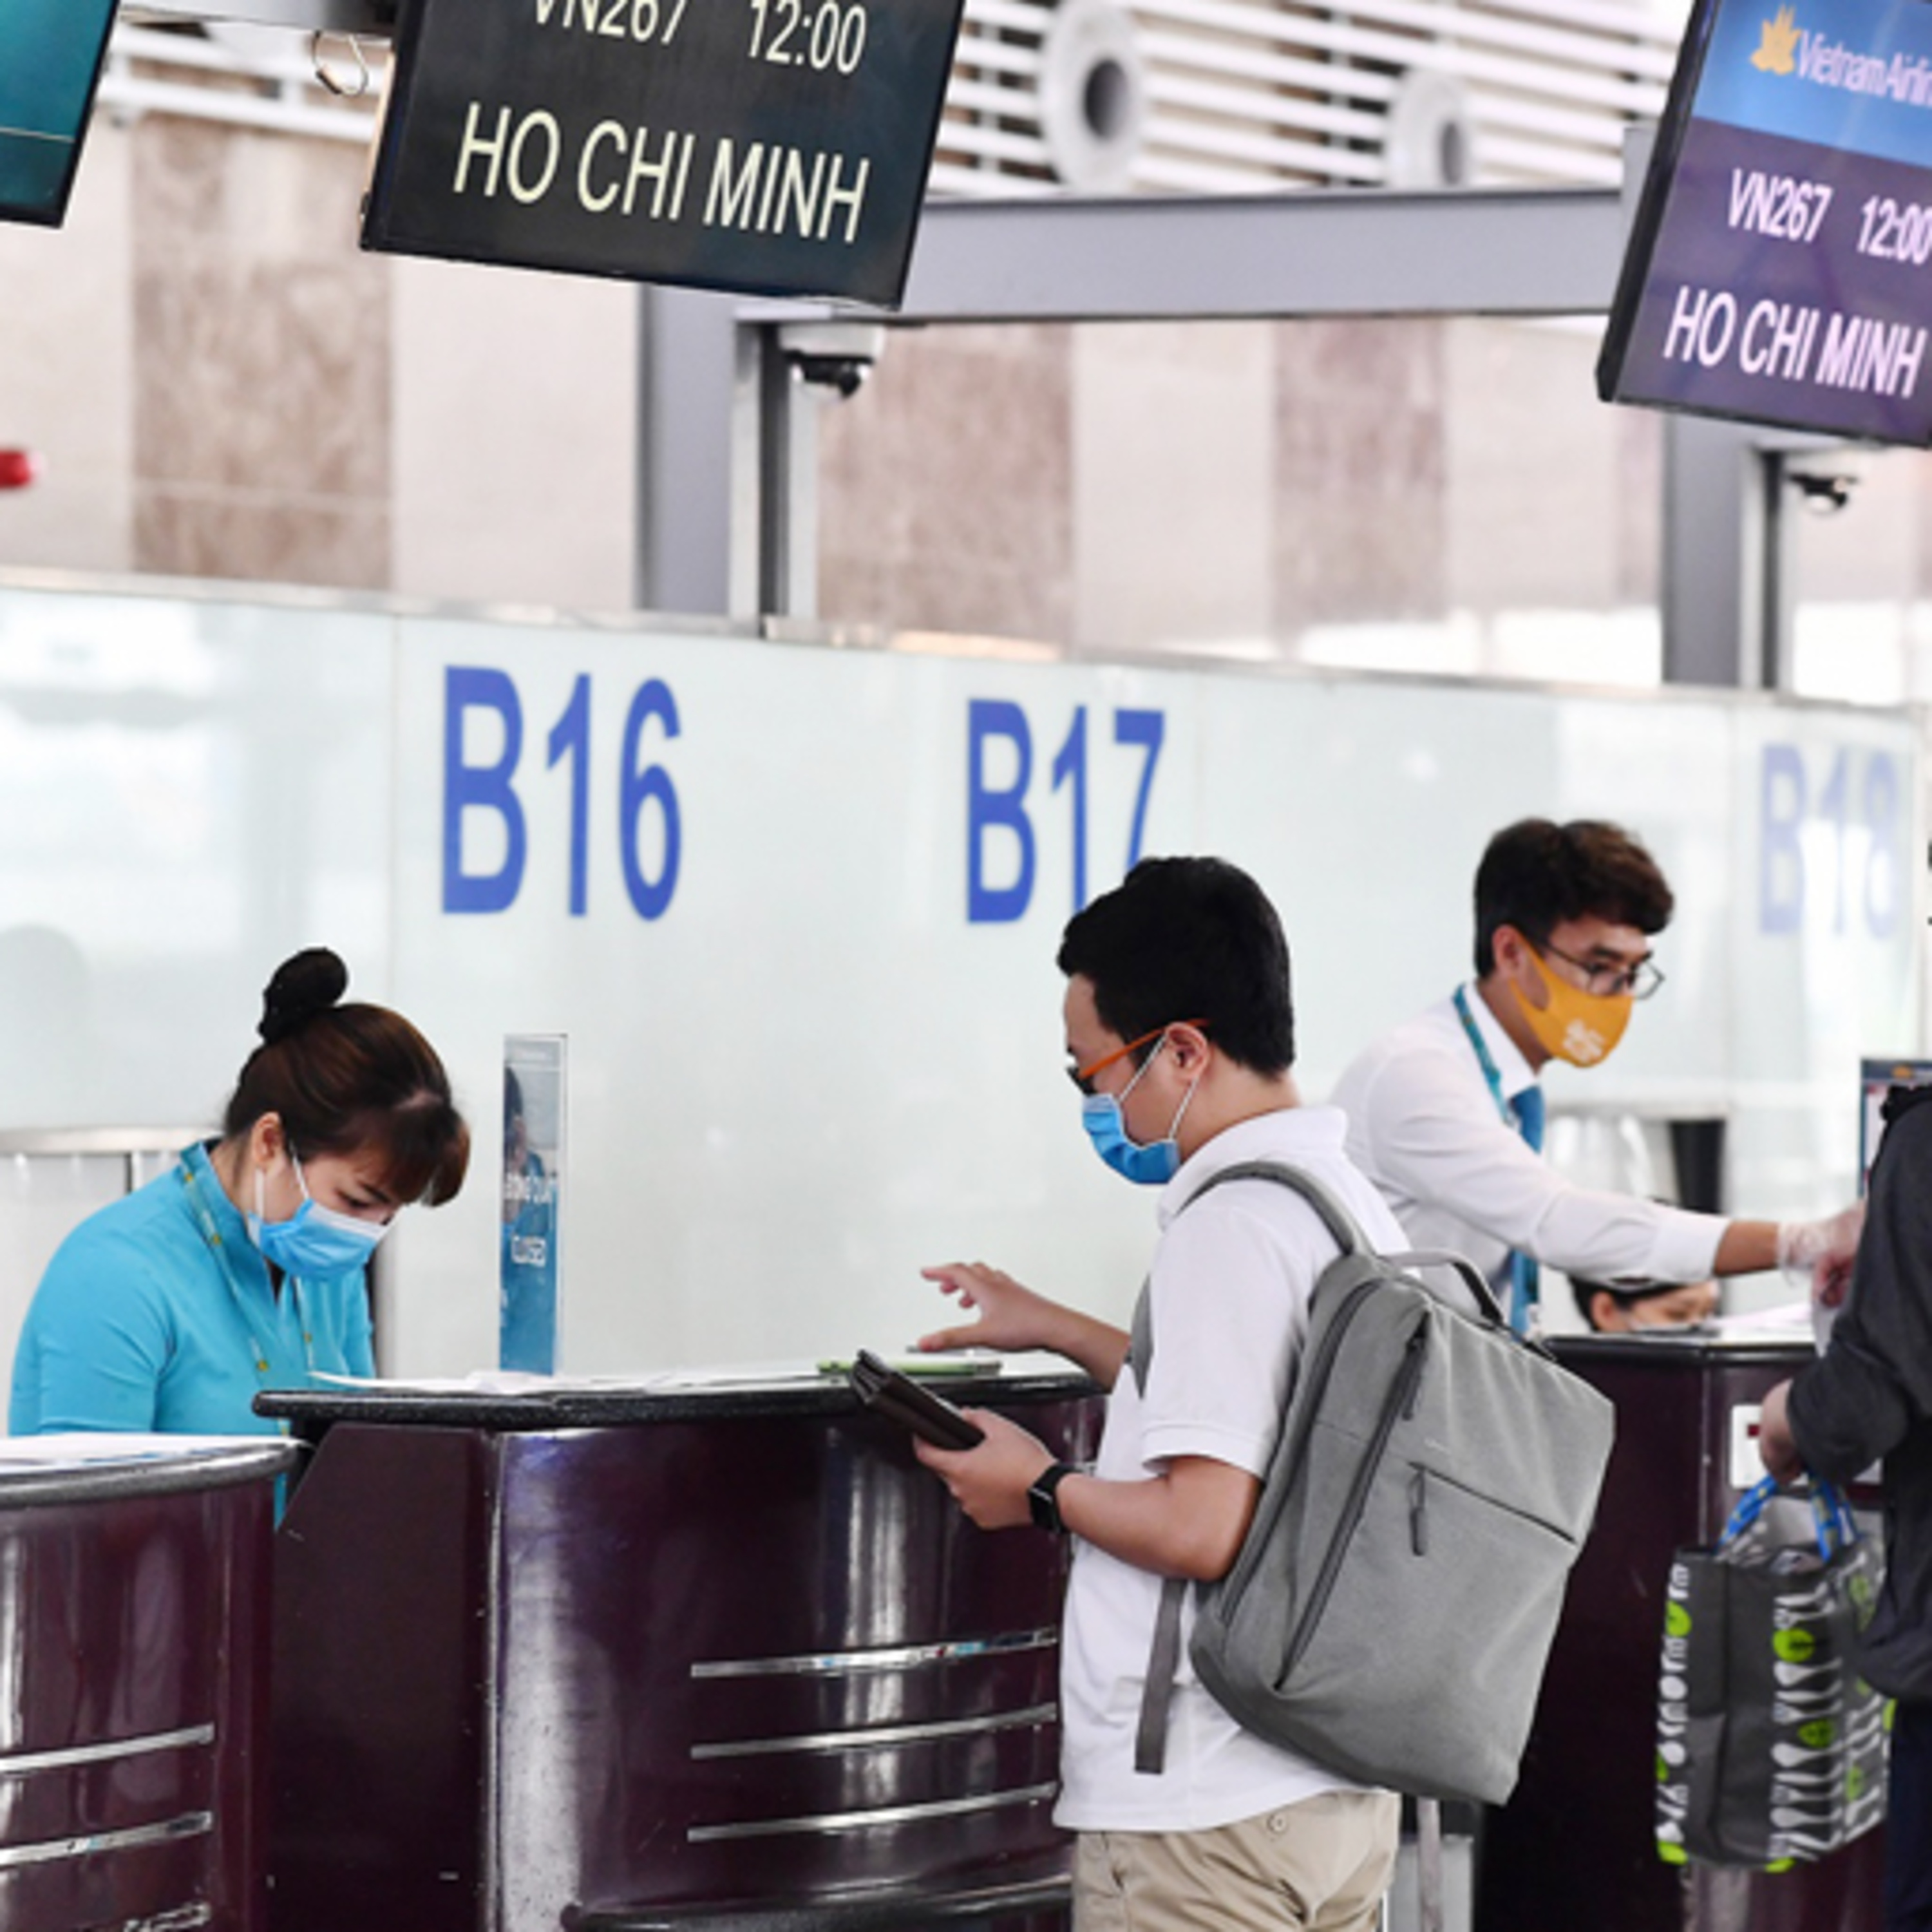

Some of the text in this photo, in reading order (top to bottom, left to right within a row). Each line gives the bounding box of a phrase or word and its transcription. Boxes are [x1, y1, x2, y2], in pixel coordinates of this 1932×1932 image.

[748, 0, 866, 73] 12:00
[453, 102, 870, 243] HO CHI MINH
[1728, 168, 1932, 265] VN267 12:00
[1663, 286, 1927, 399] HO CHI MINH
[440, 665, 681, 922] B16
[967, 698, 1166, 923] B17
[1761, 744, 1899, 939] B18
